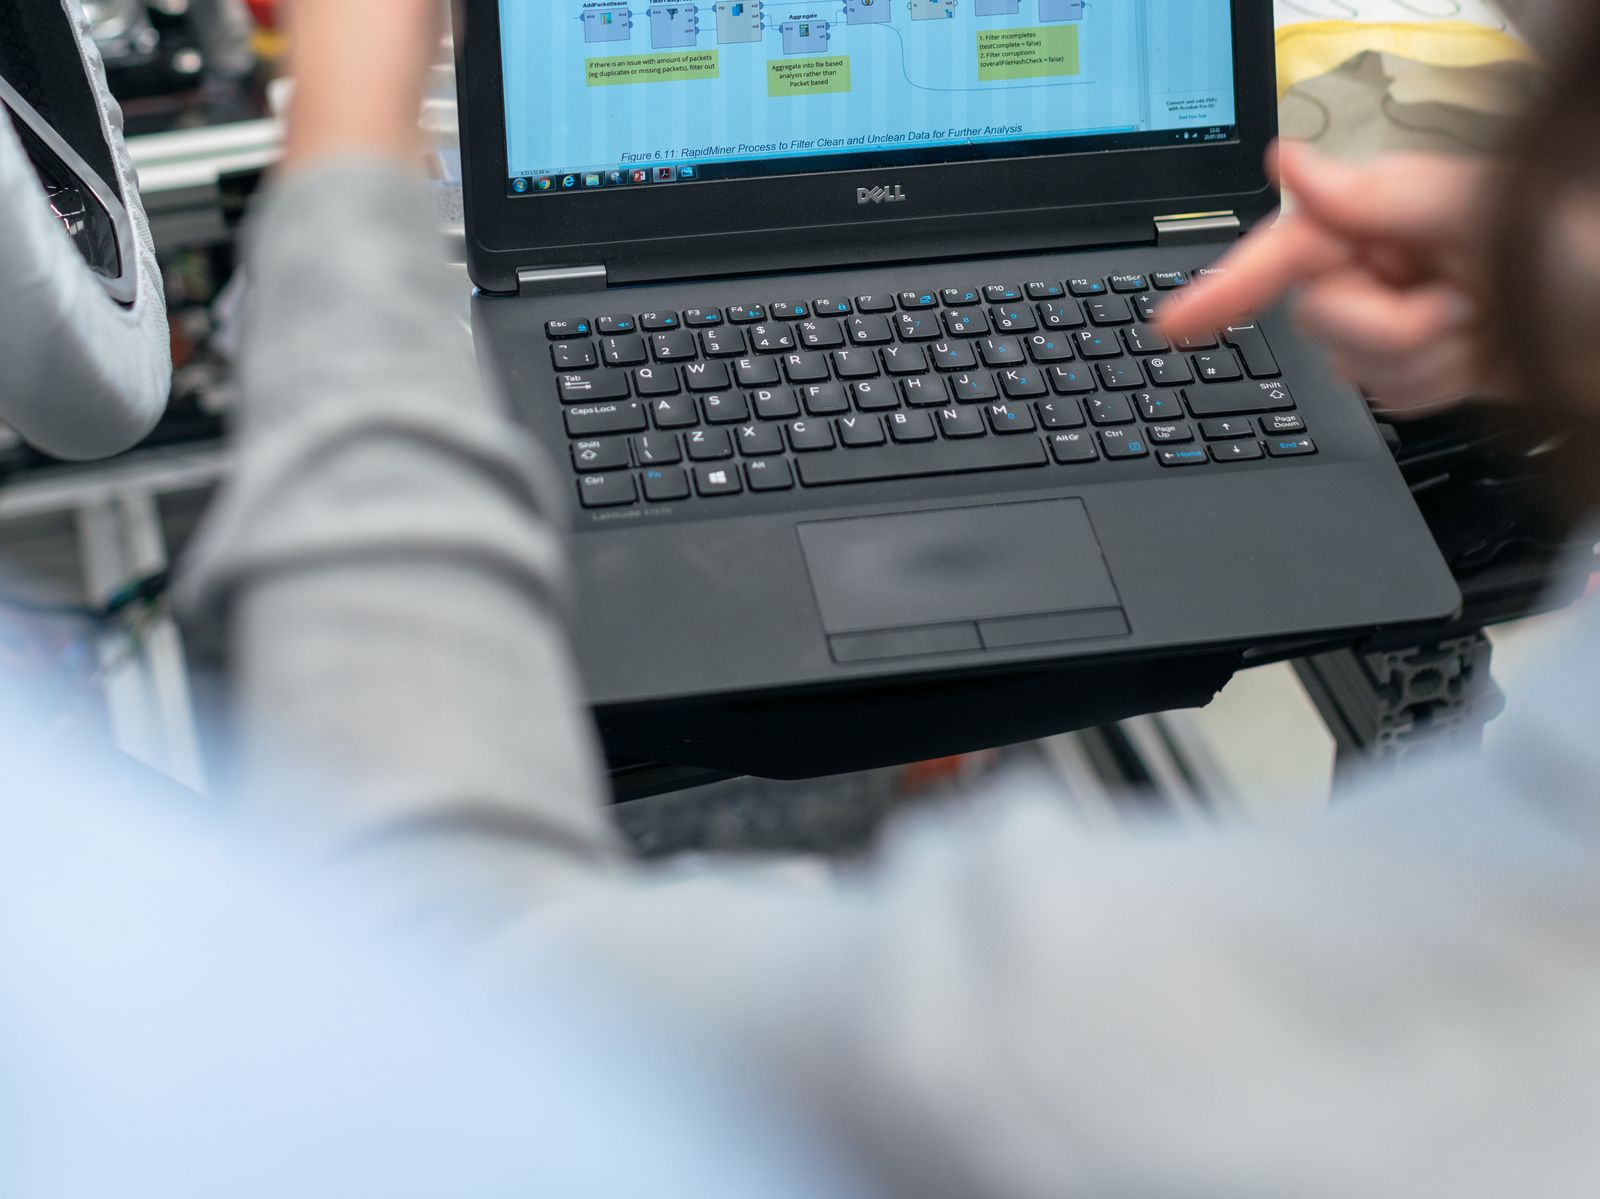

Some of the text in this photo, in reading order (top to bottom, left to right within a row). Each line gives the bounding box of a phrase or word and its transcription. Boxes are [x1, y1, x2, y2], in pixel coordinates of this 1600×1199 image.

[583, 1, 628, 9] AddPacketIssue
[789, 13, 818, 21] Aggregate
[1001, 32, 1037, 40] incompletes
[979, 40, 1042, 50] (testComplete false)
[1002, 50, 1036, 58] corruptions
[690, 55, 713, 63] packets
[980, 56, 1064, 68] (overallFileHashCheck false)
[589, 71, 599, 79] (eg
[599, 68, 630, 78] duplicates
[639, 67, 662, 76] missing
[690, 63, 703, 71] filter
[772, 62, 801, 73] Aggregate
[825, 60, 843, 68] based
[779, 69, 837, 80] analysis rather than
[790, 78, 829, 88] Packet based
[621, 124, 1023, 164] Figure 6.11: RapidMiner Process to Filter Clean and Unclean Data for Further Analysis
[857, 185, 906, 205] DELL
[804, 322, 816, 330] %
[955, 323, 964, 331] 8
[1003, 319, 1012, 327] 9
[757, 327, 766, 335] $
[780, 337, 789, 345] €
[1081, 332, 1092, 341] P
[888, 348, 898, 356] Y
[937, 343, 948, 352] U
[790, 356, 801, 365] R
[838, 352, 849, 360] T
[741, 360, 751, 369] E
[1152, 359, 1164, 367] @
[688, 364, 705, 373] W
[1057, 367, 1067, 376] L
[640, 369, 653, 378] Q
[1007, 371, 1019, 380] K
[908, 379, 921, 388] H
[960, 375, 969, 384] J
[859, 383, 871, 392] G
[1260, 382, 1281, 390] Shift
[759, 391, 771, 400] D
[810, 387, 820, 396] F
[709, 396, 721, 405] S
[1143, 394, 1150, 403] ?
[595, 405, 617, 413] Lock
[659, 401, 671, 410] A
[993, 405, 1008, 415] M
[895, 414, 907, 424] B
[944, 410, 958, 419] N
[1275, 415, 1296, 423] Page
[794, 423, 806, 432] C
[844, 418, 856, 428] V
[743, 427, 756, 437] X
[1155, 425, 1176, 433] Page
[692, 432, 704, 441] Z
[1105, 430, 1123, 438] Ctrl
[578, 441, 601, 449] Shift
